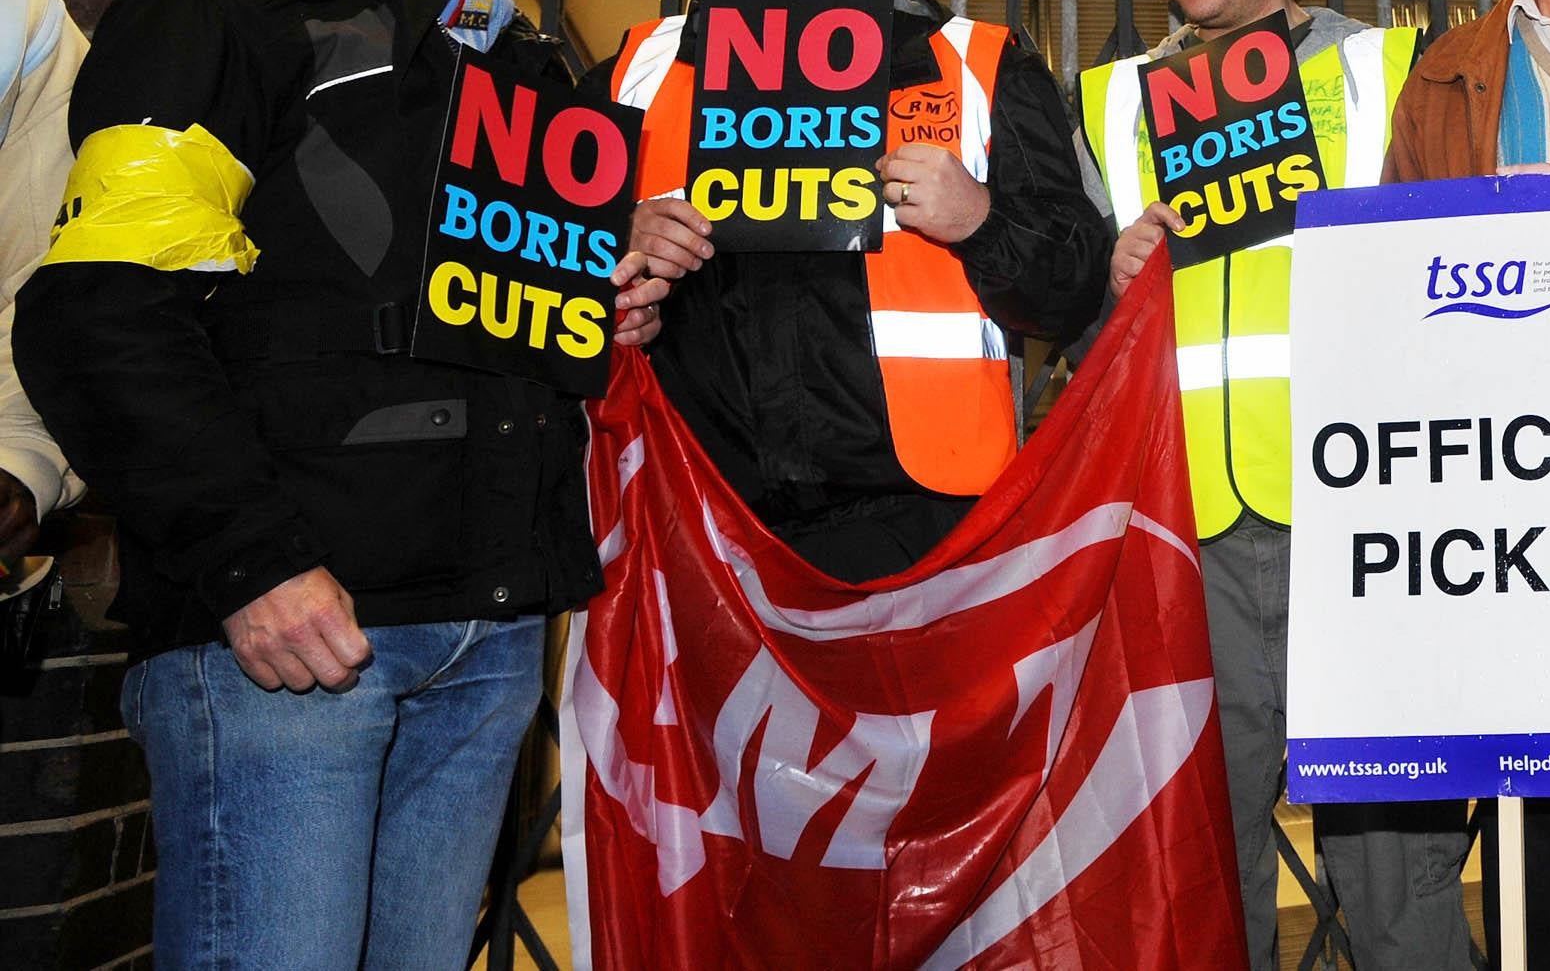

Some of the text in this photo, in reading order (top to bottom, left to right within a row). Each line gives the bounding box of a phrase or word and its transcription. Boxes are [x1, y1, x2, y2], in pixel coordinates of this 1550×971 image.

[703, 7, 884, 92] NO
[1146, 30, 1291, 138] NO
[450, 63, 628, 207] NO
[699, 106, 882, 149] BORIS
[909, 98, 955, 115] RMT
[1160, 101, 1307, 183] BORIS
[439, 184, 618, 279] BORIS
[691, 167, 877, 221] CUTS
[1168, 153, 1320, 239] CUTS
[428, 261, 605, 359] CUTS
[1427, 255, 1527, 300] tssa
[1298, 756, 1448, 779] www.tssa.org.uk
